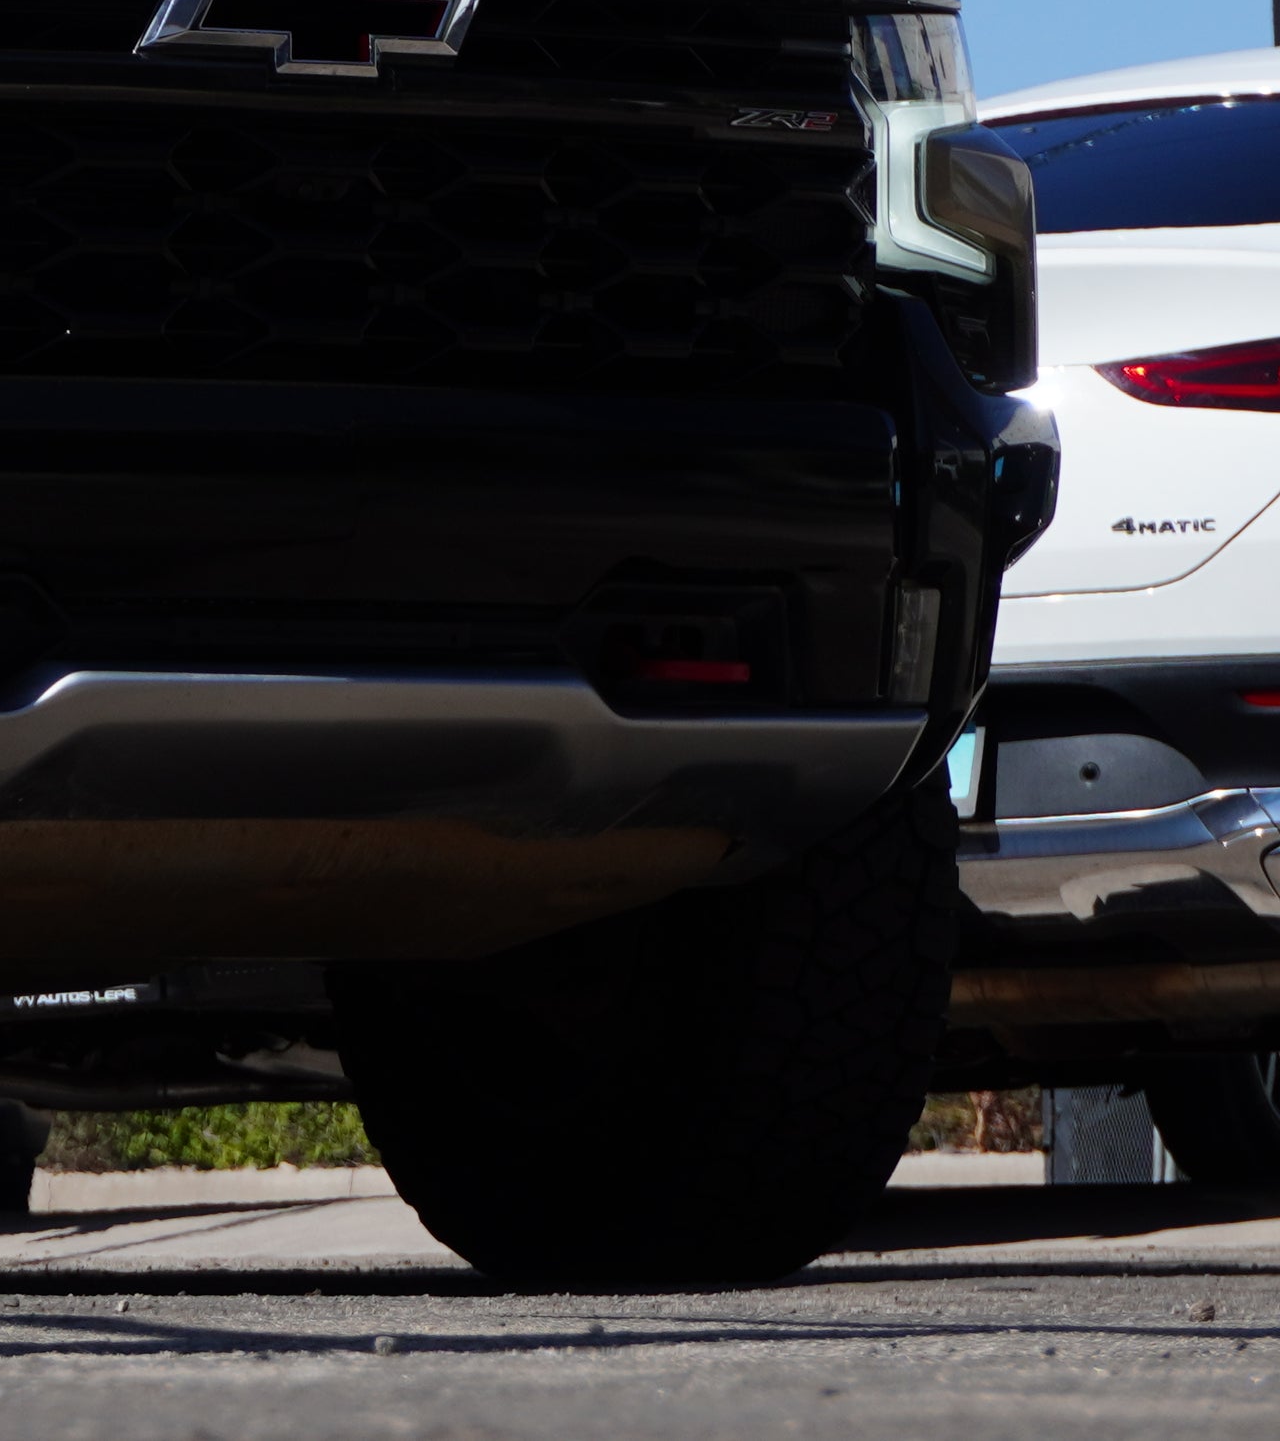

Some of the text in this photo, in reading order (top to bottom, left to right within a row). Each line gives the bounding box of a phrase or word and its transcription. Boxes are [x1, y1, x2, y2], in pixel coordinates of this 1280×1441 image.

[729, 109, 839, 132] ZR2
[1110, 516, 1217, 535] 4MATIC
[37, 990, 90, 1005] AUTOS
[93, 987, 137, 1002] LEPE
